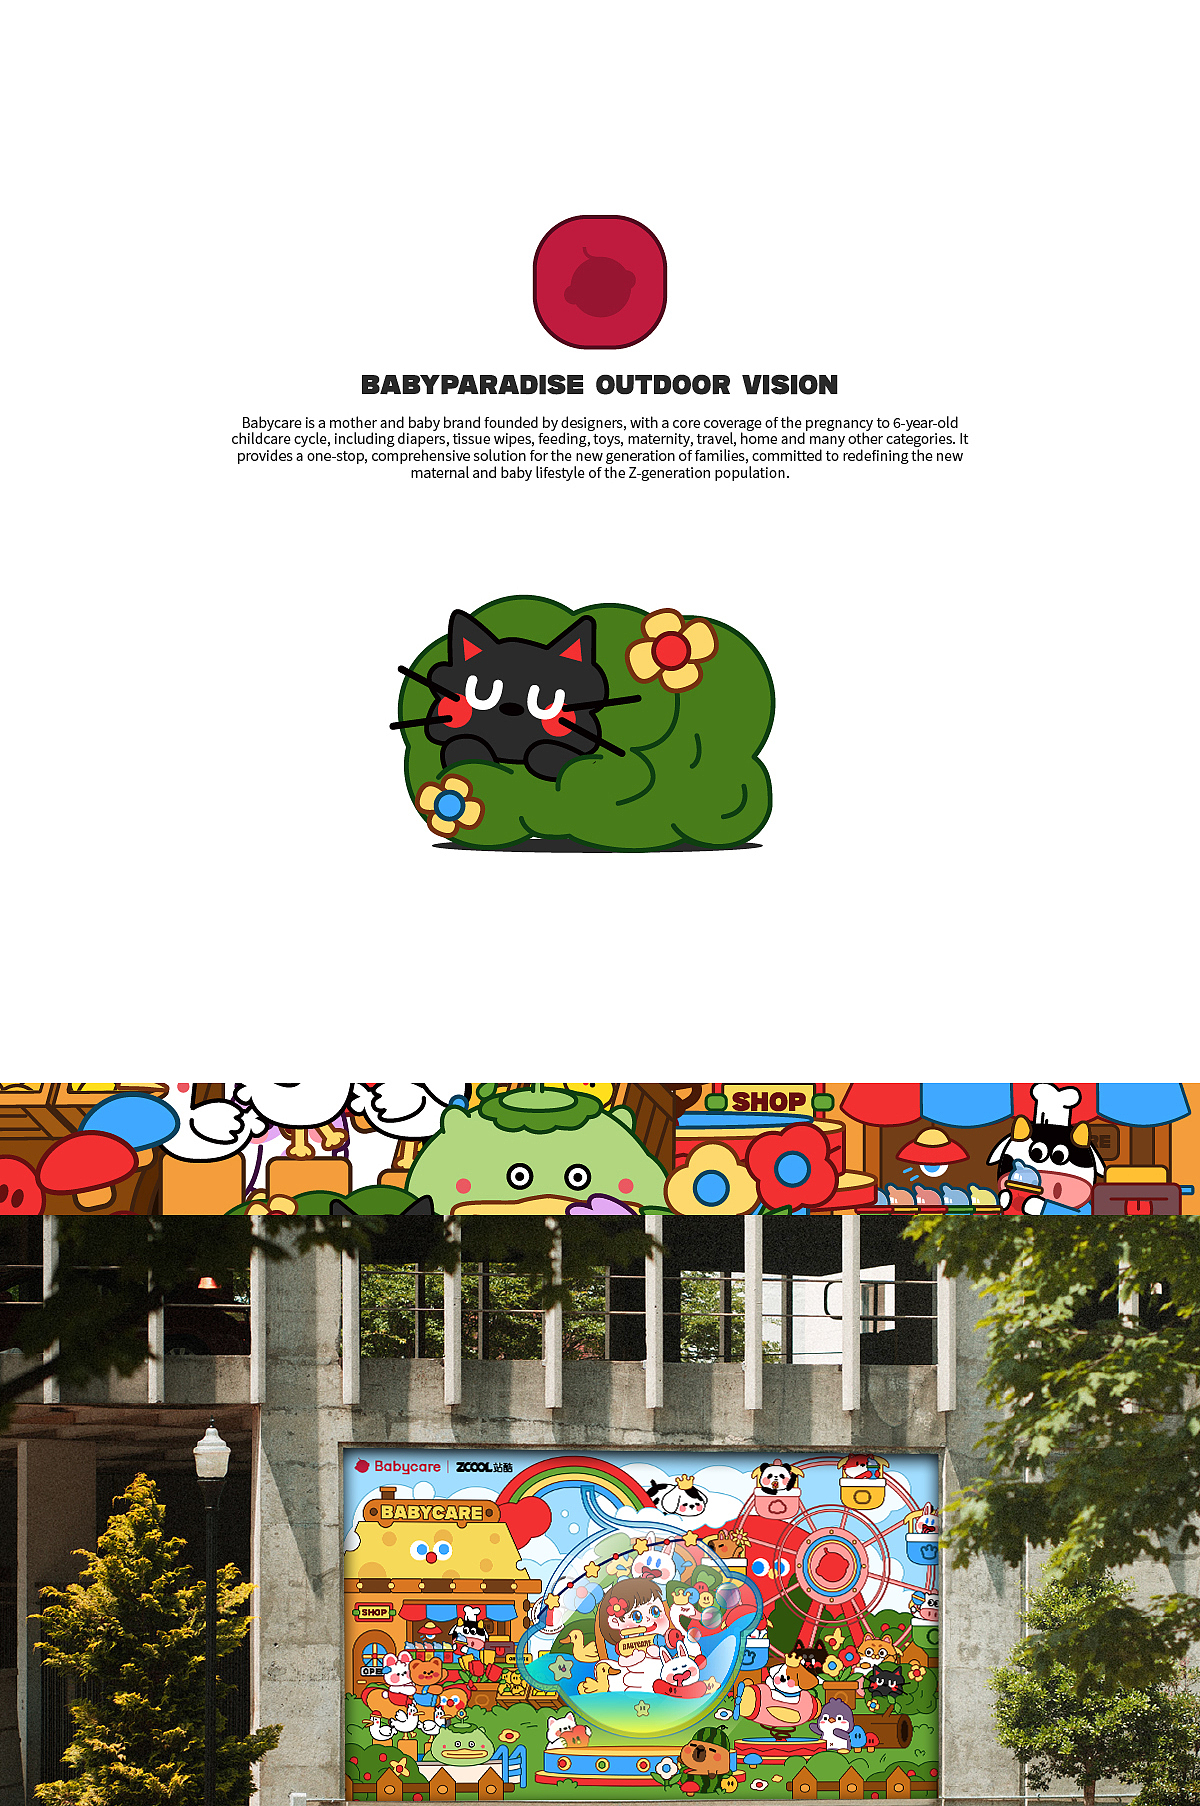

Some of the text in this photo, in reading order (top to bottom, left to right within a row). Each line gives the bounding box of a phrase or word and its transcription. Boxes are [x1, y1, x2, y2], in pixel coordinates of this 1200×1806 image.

[733, 1092, 806, 1111] SHOP
[374, 1460, 441, 1474] Babycare
[380, 1504, 483, 1520] BABYCARE
